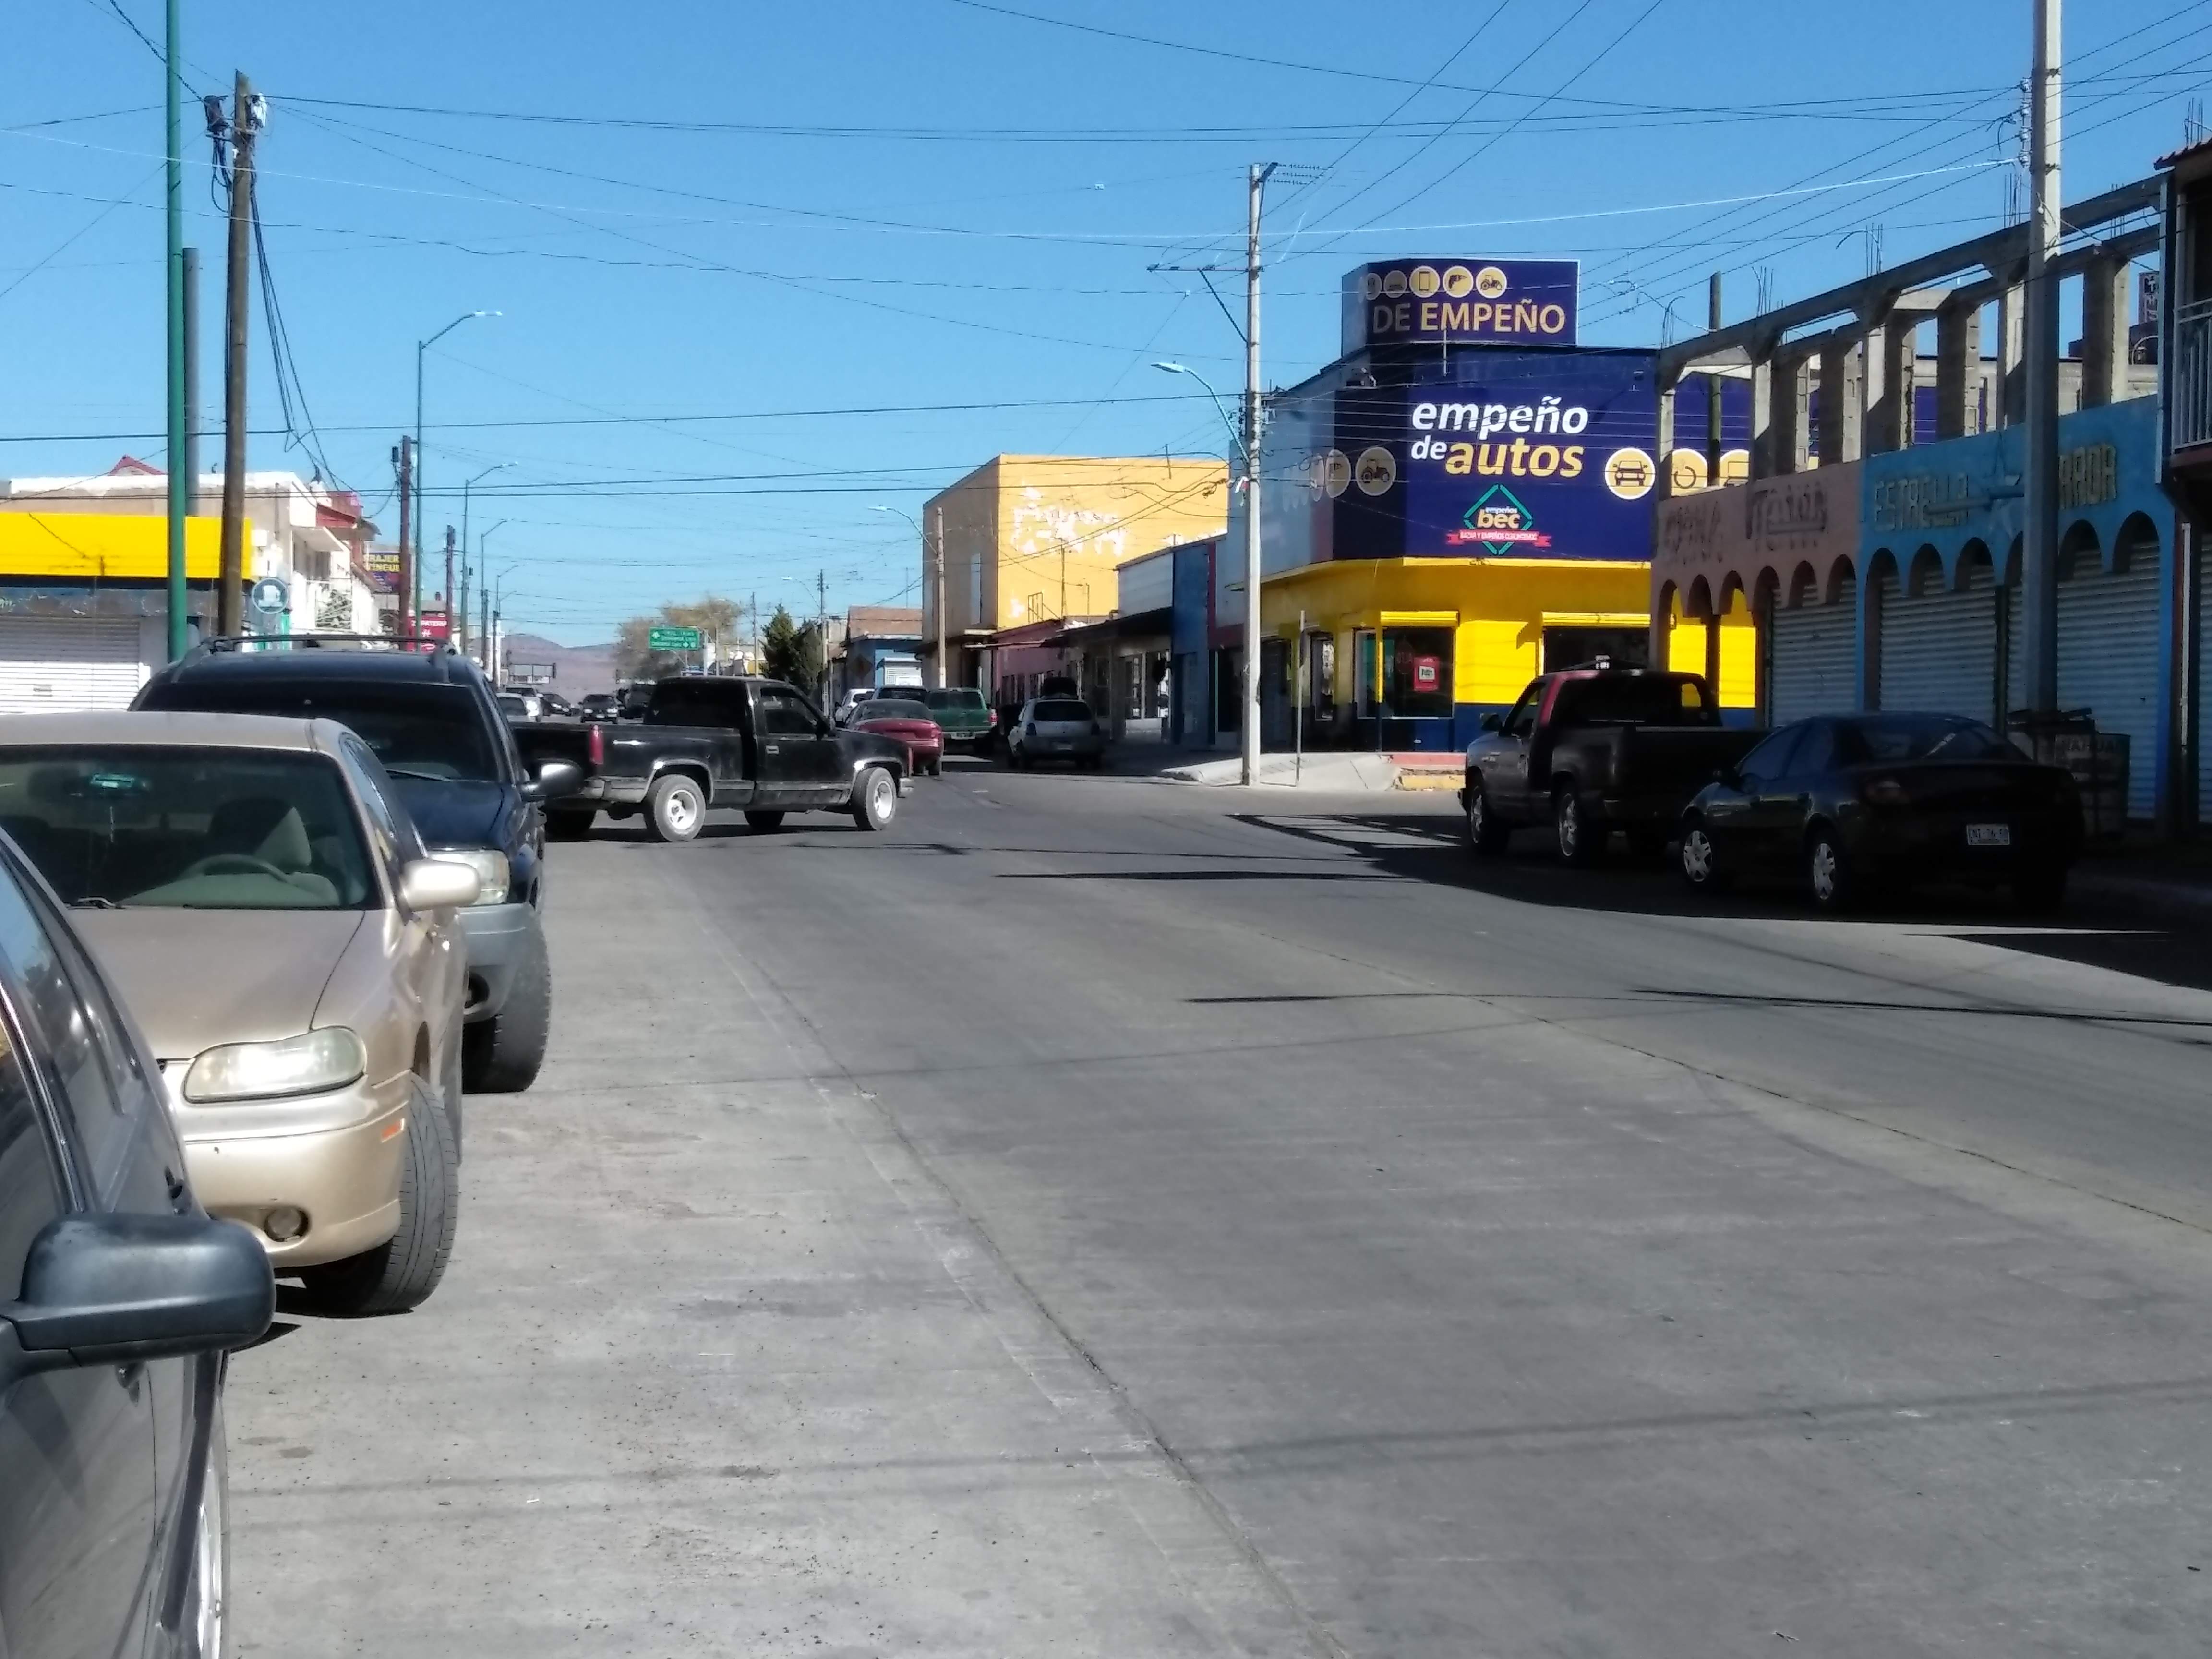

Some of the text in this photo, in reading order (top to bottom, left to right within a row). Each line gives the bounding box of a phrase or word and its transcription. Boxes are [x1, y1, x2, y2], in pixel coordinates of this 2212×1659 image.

[1373, 298, 1565, 334] DE EMPEÑO
[1412, 395, 1589, 440] empeño
[1411, 434, 1585, 477] de autos
[1477, 509, 1521, 529] bec
